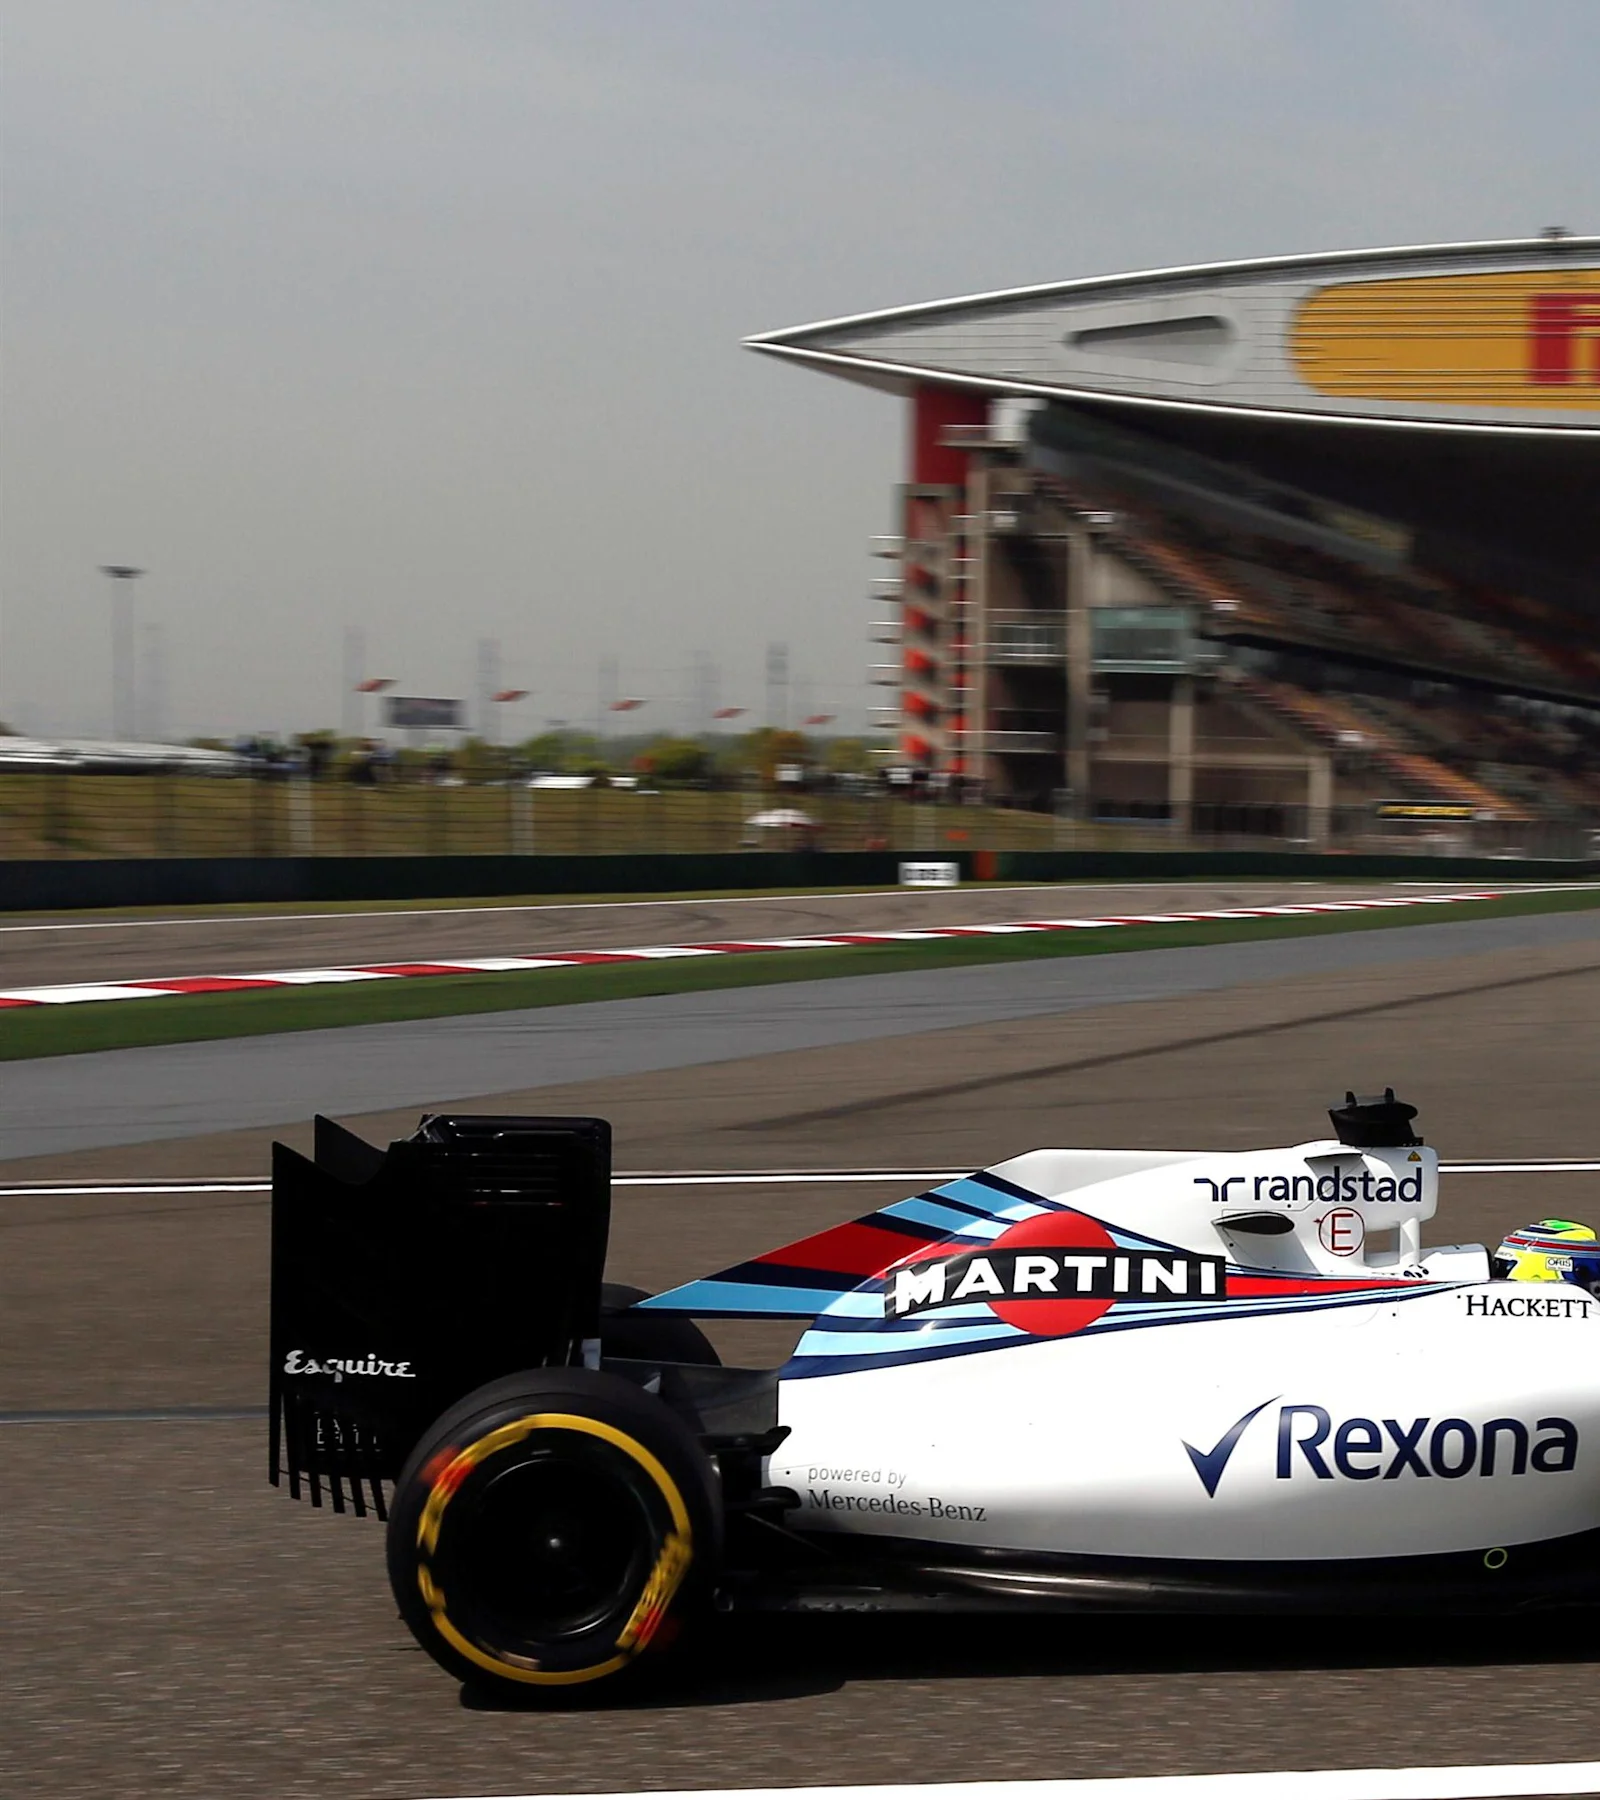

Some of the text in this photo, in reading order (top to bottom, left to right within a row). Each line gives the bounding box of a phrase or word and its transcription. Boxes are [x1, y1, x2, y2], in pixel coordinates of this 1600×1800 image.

[1254, 1166, 1422, 1202] randstad
[1331, 1213, 1354, 1250] E
[895, 1255, 1217, 1315] MARTINI
[1466, 1295, 1592, 1319] HACKETT
[284, 1350, 416, 1383] Esquire
[1276, 1404, 1579, 1480] Rexona
[808, 1467, 907, 1488] powered by
[807, 1489, 988, 1522] Mercedes-Benz
